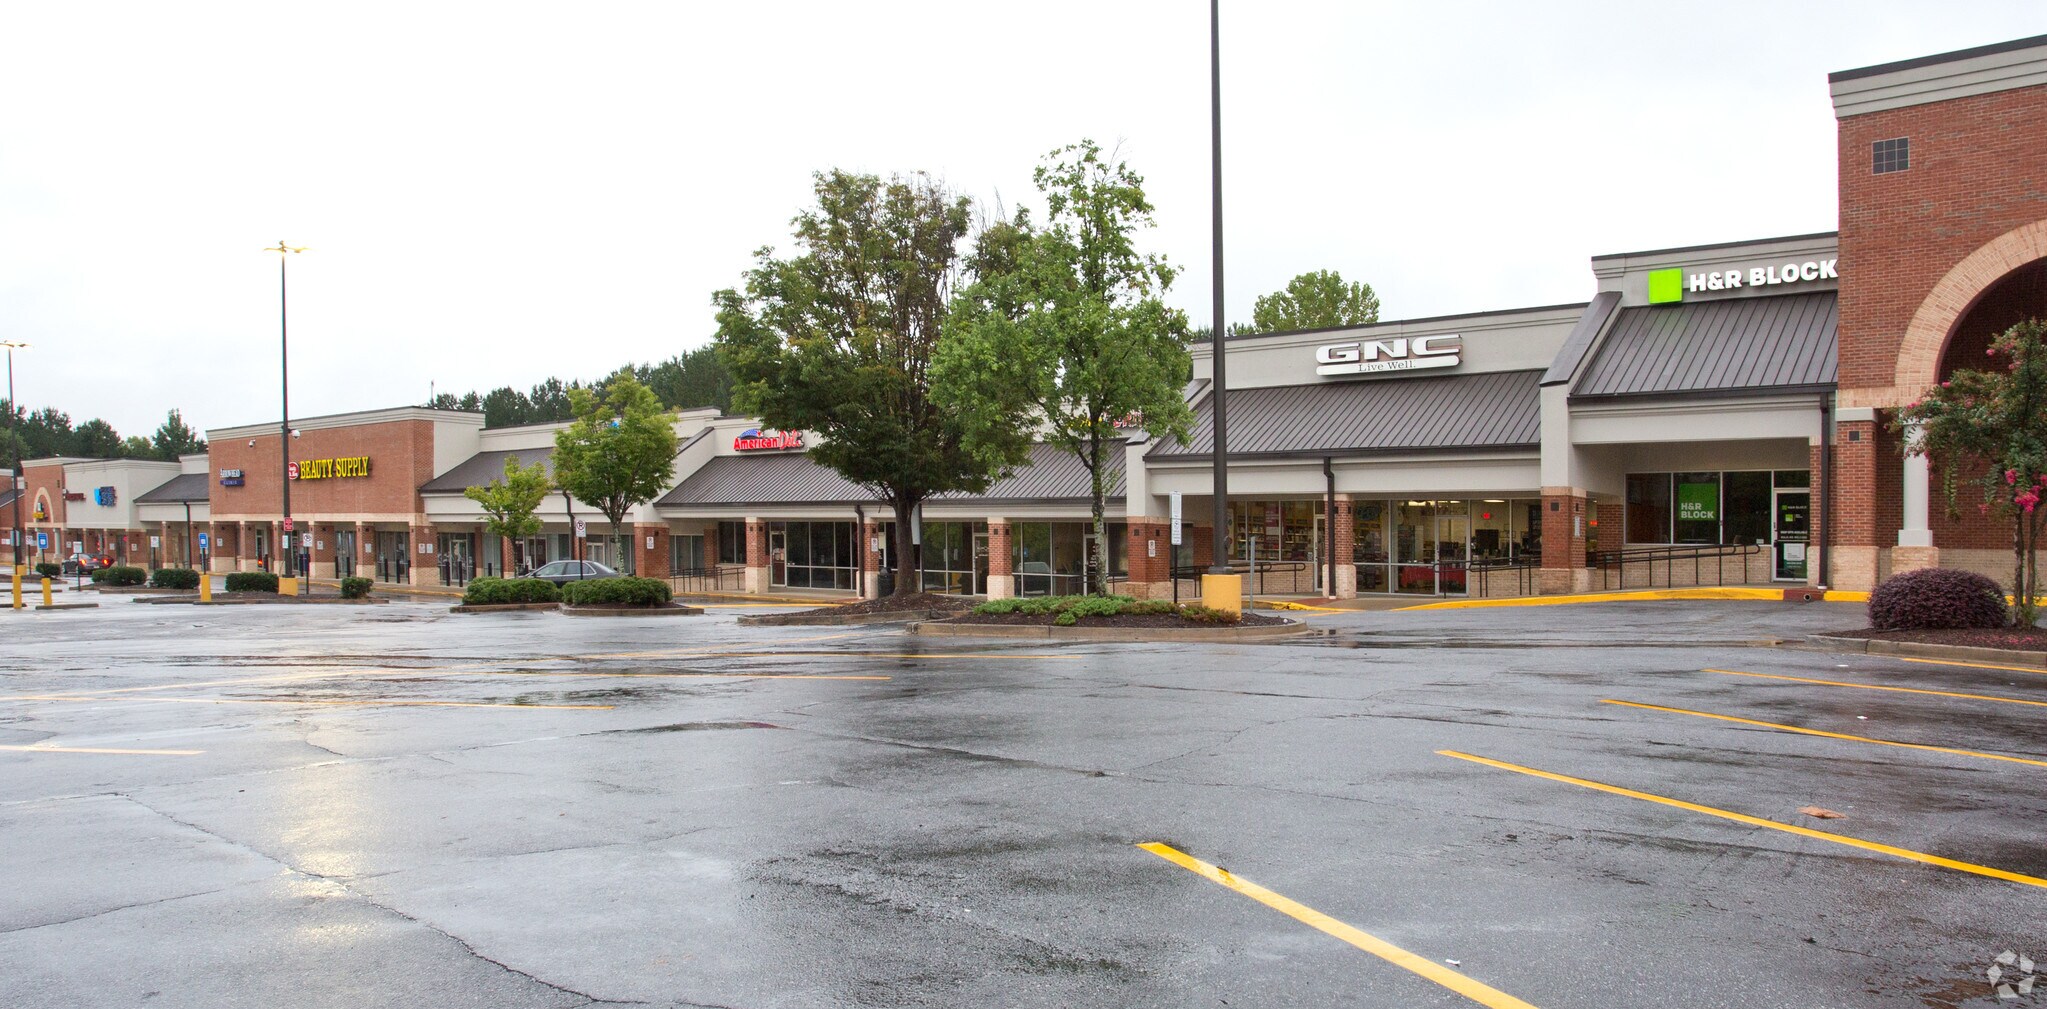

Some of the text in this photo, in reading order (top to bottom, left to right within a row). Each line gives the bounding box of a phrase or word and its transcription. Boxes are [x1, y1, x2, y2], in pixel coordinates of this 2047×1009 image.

[1689, 259, 1839, 293] H&R BLOCK
[1316, 334, 1460, 364] GNC
[1359, 360, 1416, 372] Live Well.
[733, 436, 778, 450] American
[300, 459, 333, 479] BEAUTY
[336, 456, 369, 478] SUPPLY
[1680, 502, 1702, 511] H&R
[1680, 510, 1714, 519] BLOCK
